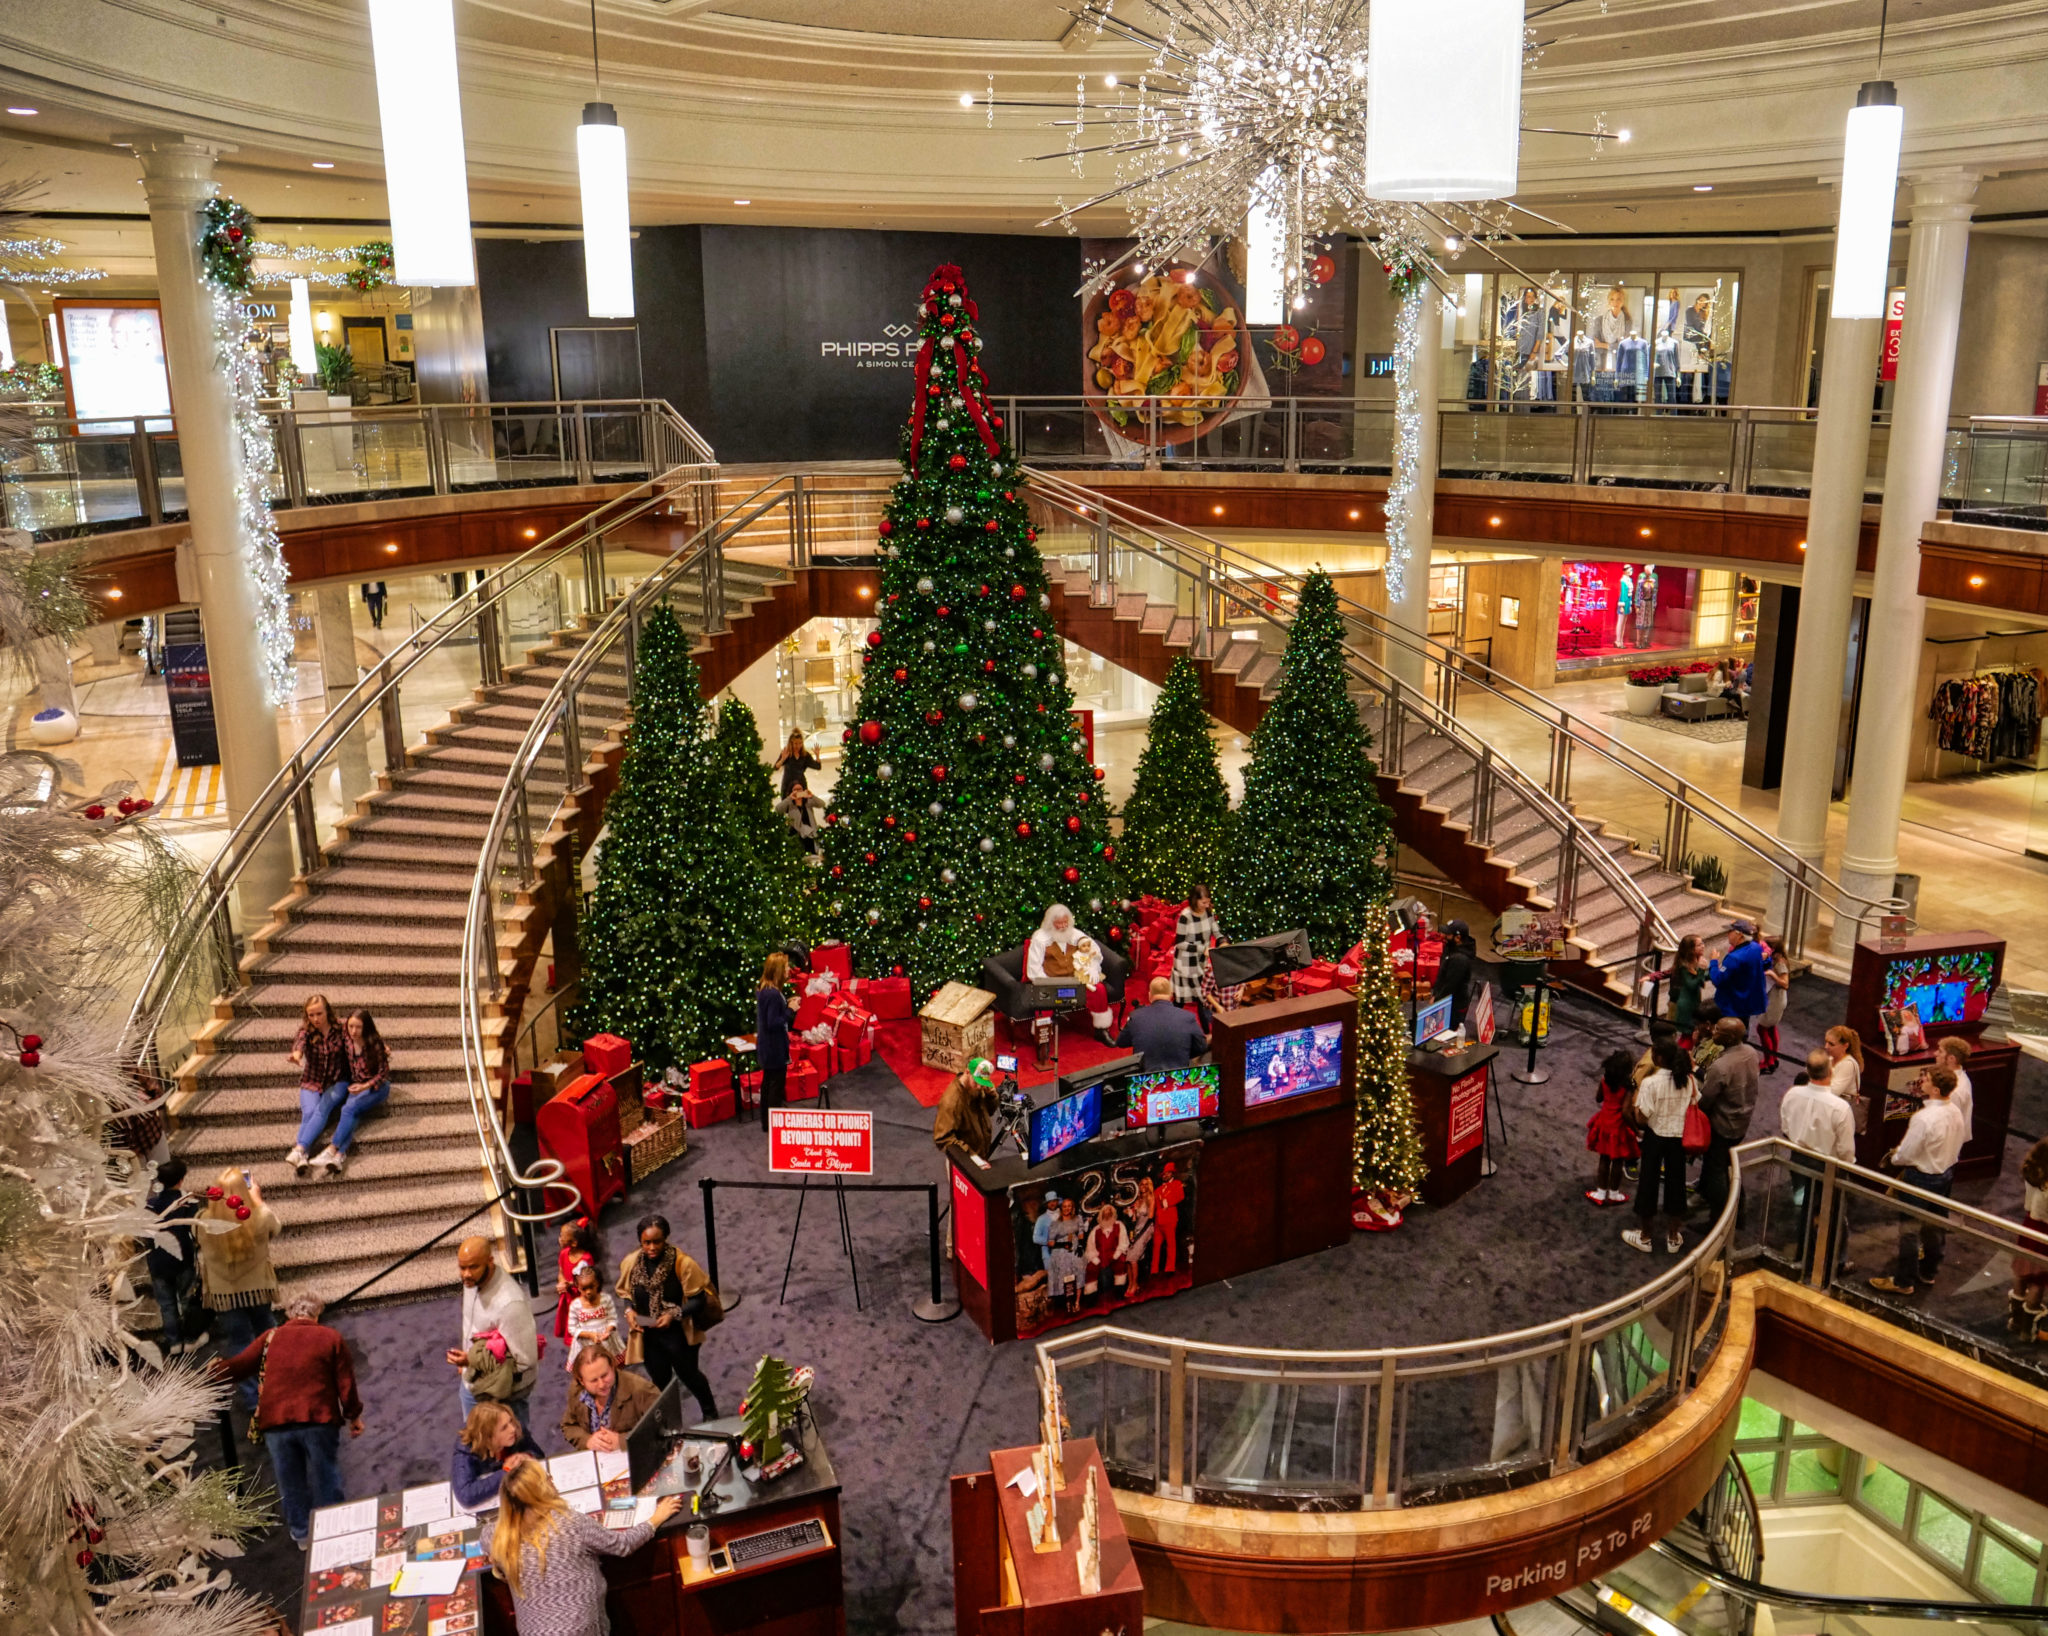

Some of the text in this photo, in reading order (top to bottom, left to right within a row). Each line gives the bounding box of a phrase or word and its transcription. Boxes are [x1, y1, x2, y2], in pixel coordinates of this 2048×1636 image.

[821, 342, 900, 357] PHIPPS
[926, 1023, 955, 1050] Wish
[966, 1025, 989, 1046] Wish
[1452, 1076, 1475, 1095] No Flash
[1452, 1081, 1485, 1104] Photography
[772, 1113, 869, 1131] NO CAMERAS OR PHONES
[780, 1130, 861, 1147] BEYOND THIS POINT!
[803, 1147, 822, 1157] Thank
[790, 1156, 853, 1171] Santa at Phipps
[955, 1174, 969, 1198] EXIT
[1486, 1512, 1653, 1596] Parking P3 To P2
